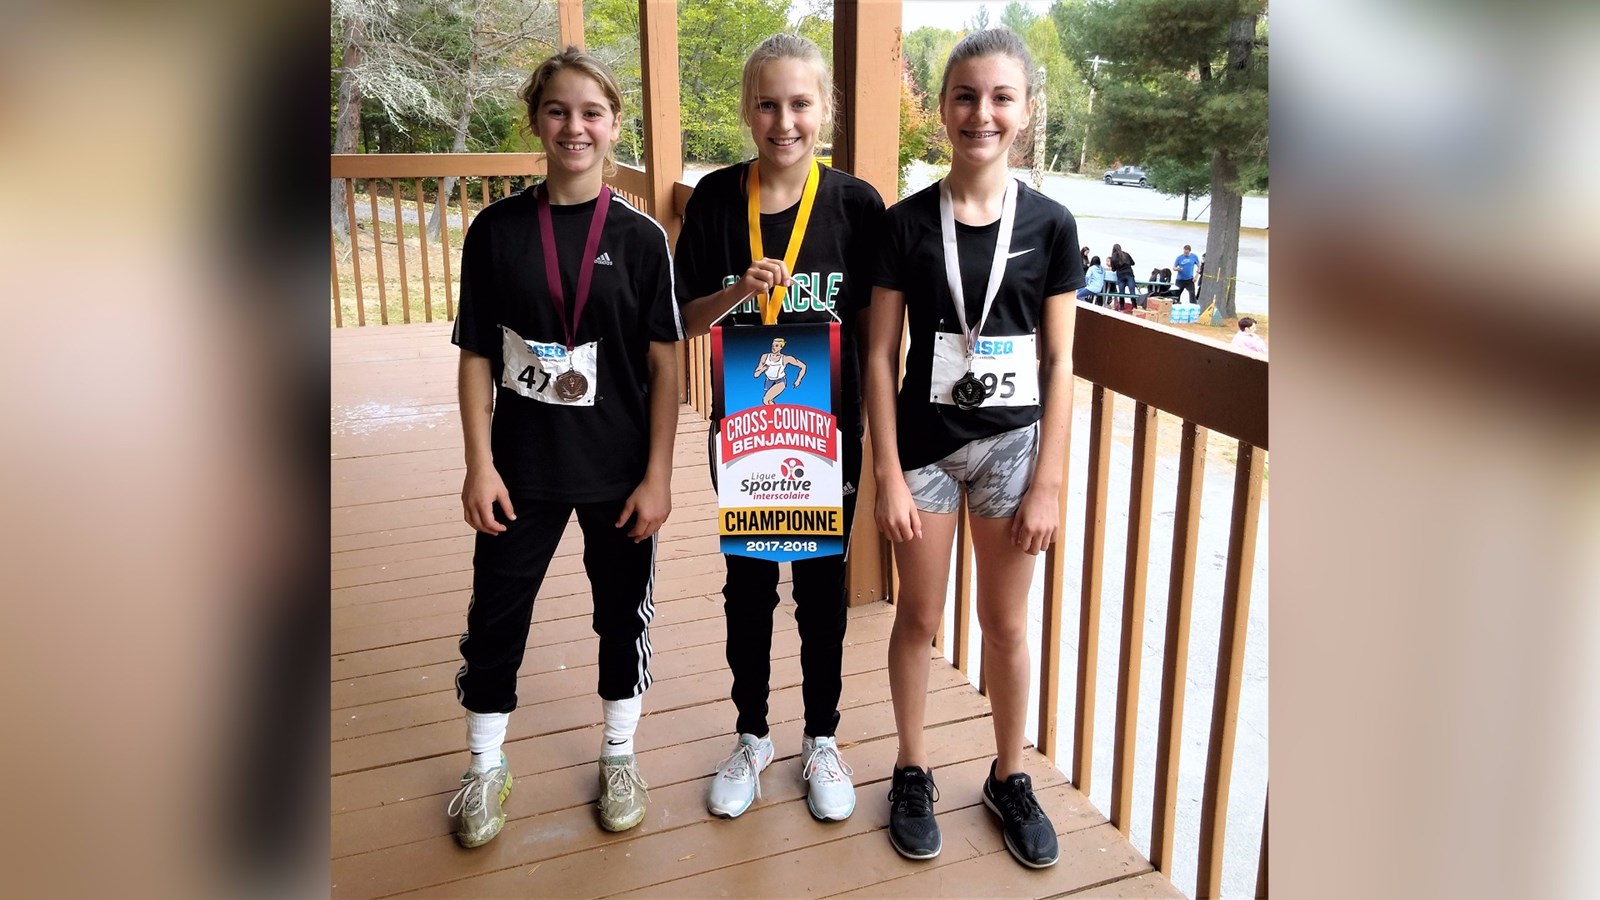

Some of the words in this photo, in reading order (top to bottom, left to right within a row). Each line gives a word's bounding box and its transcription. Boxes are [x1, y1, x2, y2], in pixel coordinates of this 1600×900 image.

[527, 344, 567, 358] SEQ
[726, 407, 832, 442] CROSS-COUNTRY
[732, 432, 828, 455] BENJAMINE
[751, 472, 776, 482] Ligue
[740, 478, 812, 495] Sportive
[753, 492, 811, 500] interscolaire
[725, 510, 838, 532] CHAMPIONNE
[746, 541, 818, 552] 2017-2018
